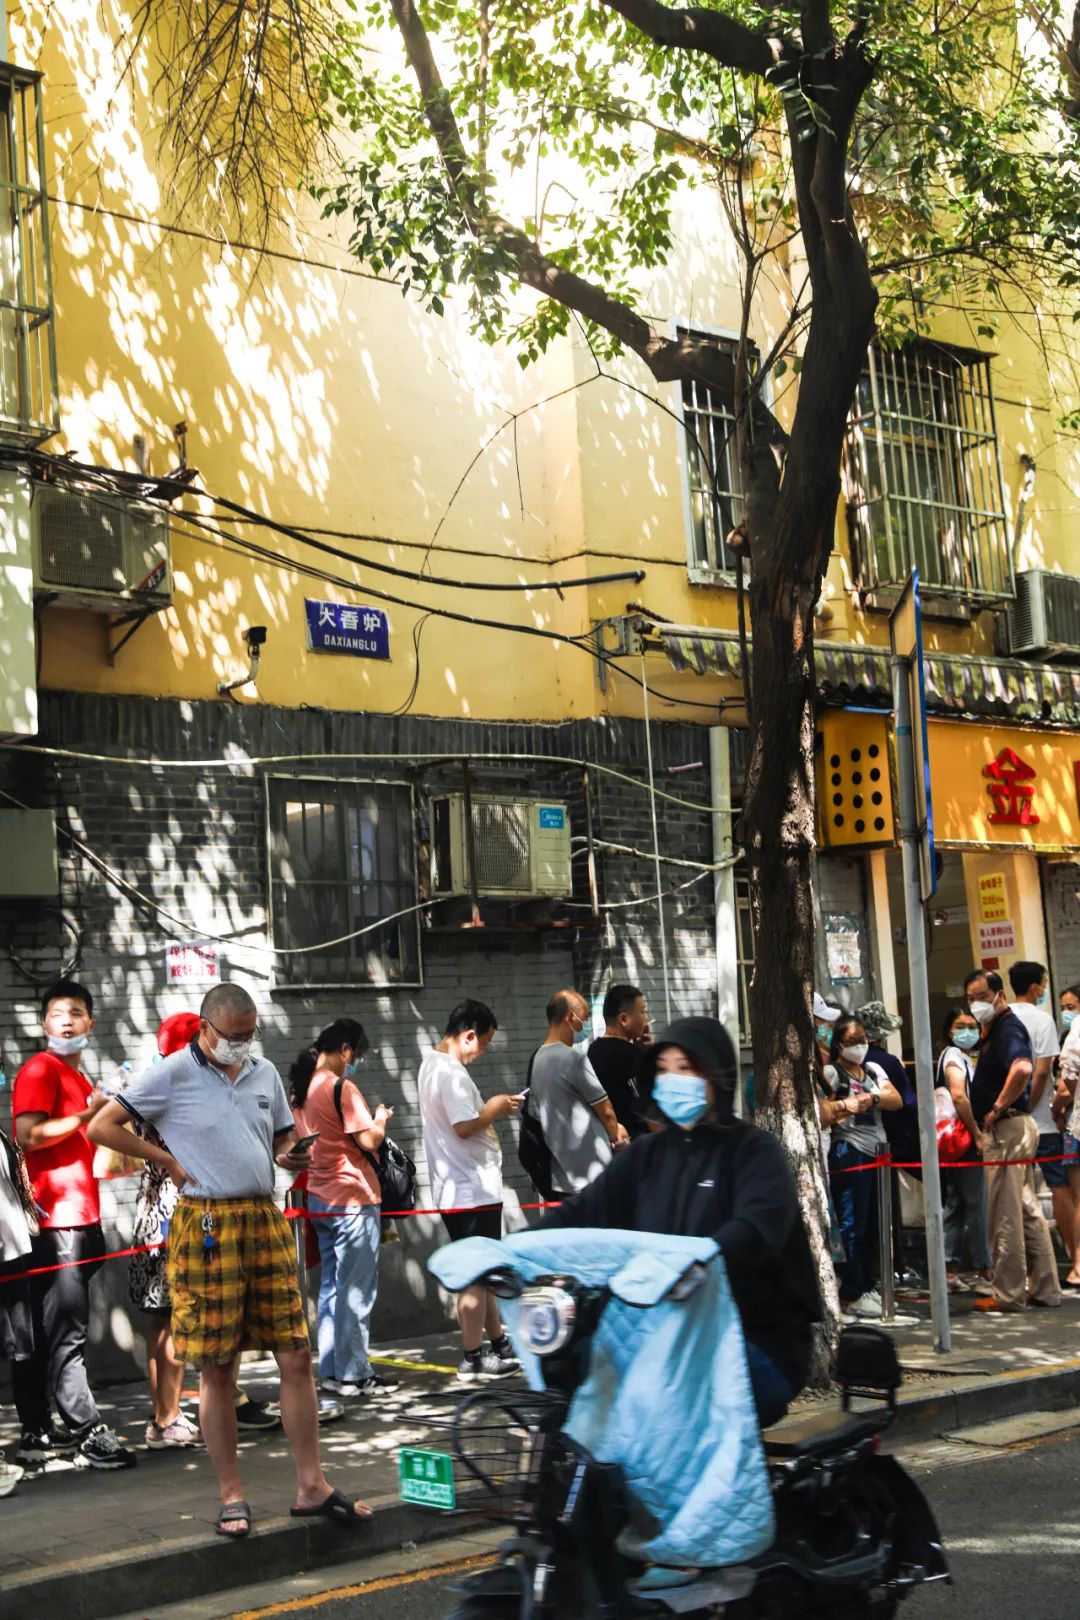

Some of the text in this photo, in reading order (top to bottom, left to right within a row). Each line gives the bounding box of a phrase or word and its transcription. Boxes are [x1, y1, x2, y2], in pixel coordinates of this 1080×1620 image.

[318, 606, 381, 633] 大香炉
[324, 634, 377, 652] DAXIANGLU
